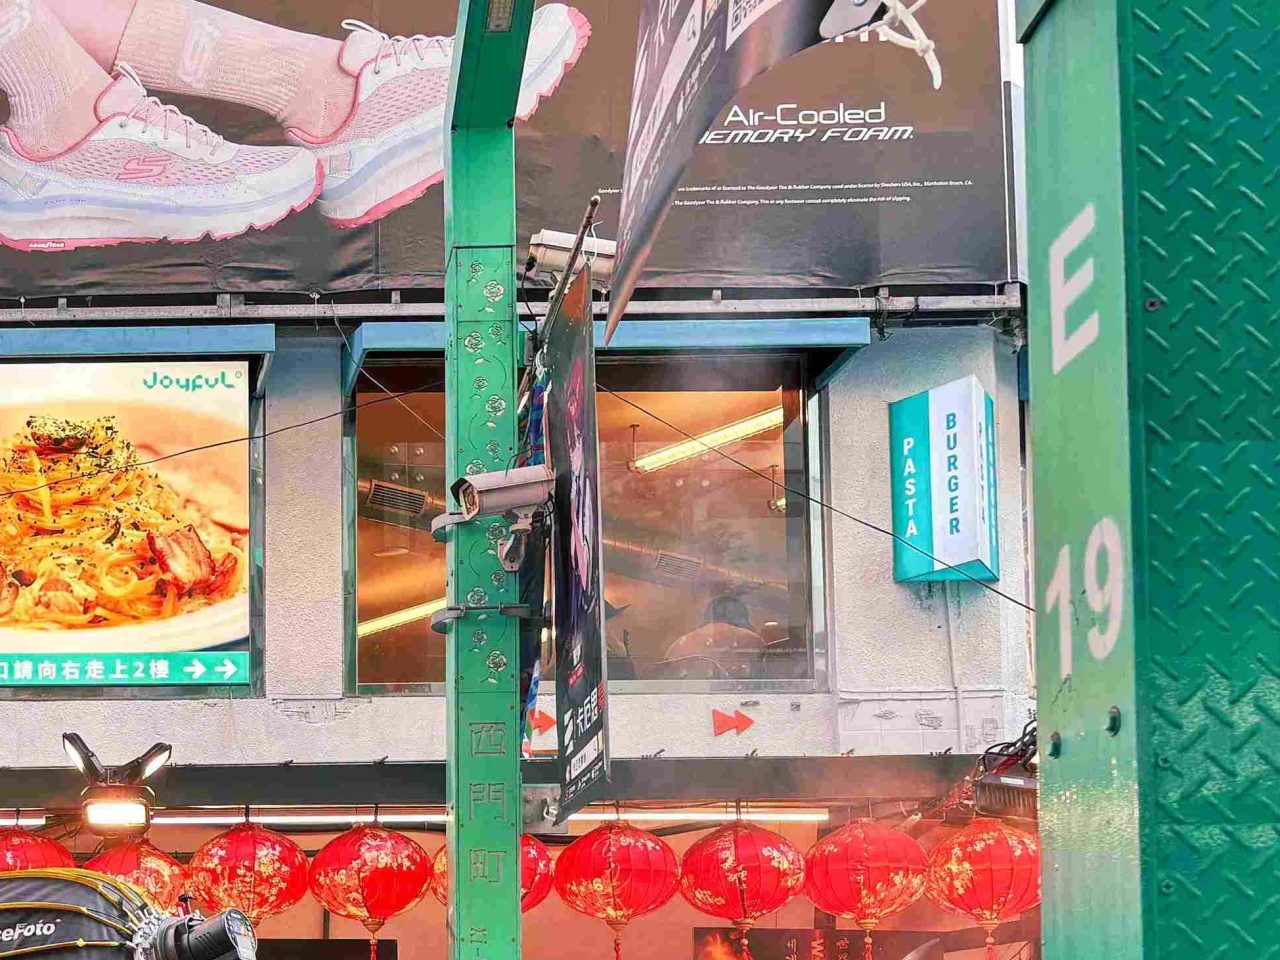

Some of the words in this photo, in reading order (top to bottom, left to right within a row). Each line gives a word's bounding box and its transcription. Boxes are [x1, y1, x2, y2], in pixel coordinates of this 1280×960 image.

[723, 101, 886, 127] Air-Cooled
[1048, 202, 1100, 375] E
[902, 437, 919, 539] PASTA
[945, 412, 961, 536] BURGER
[1045, 516, 1124, 681] 19
[469, 722, 507, 883] 西門町
